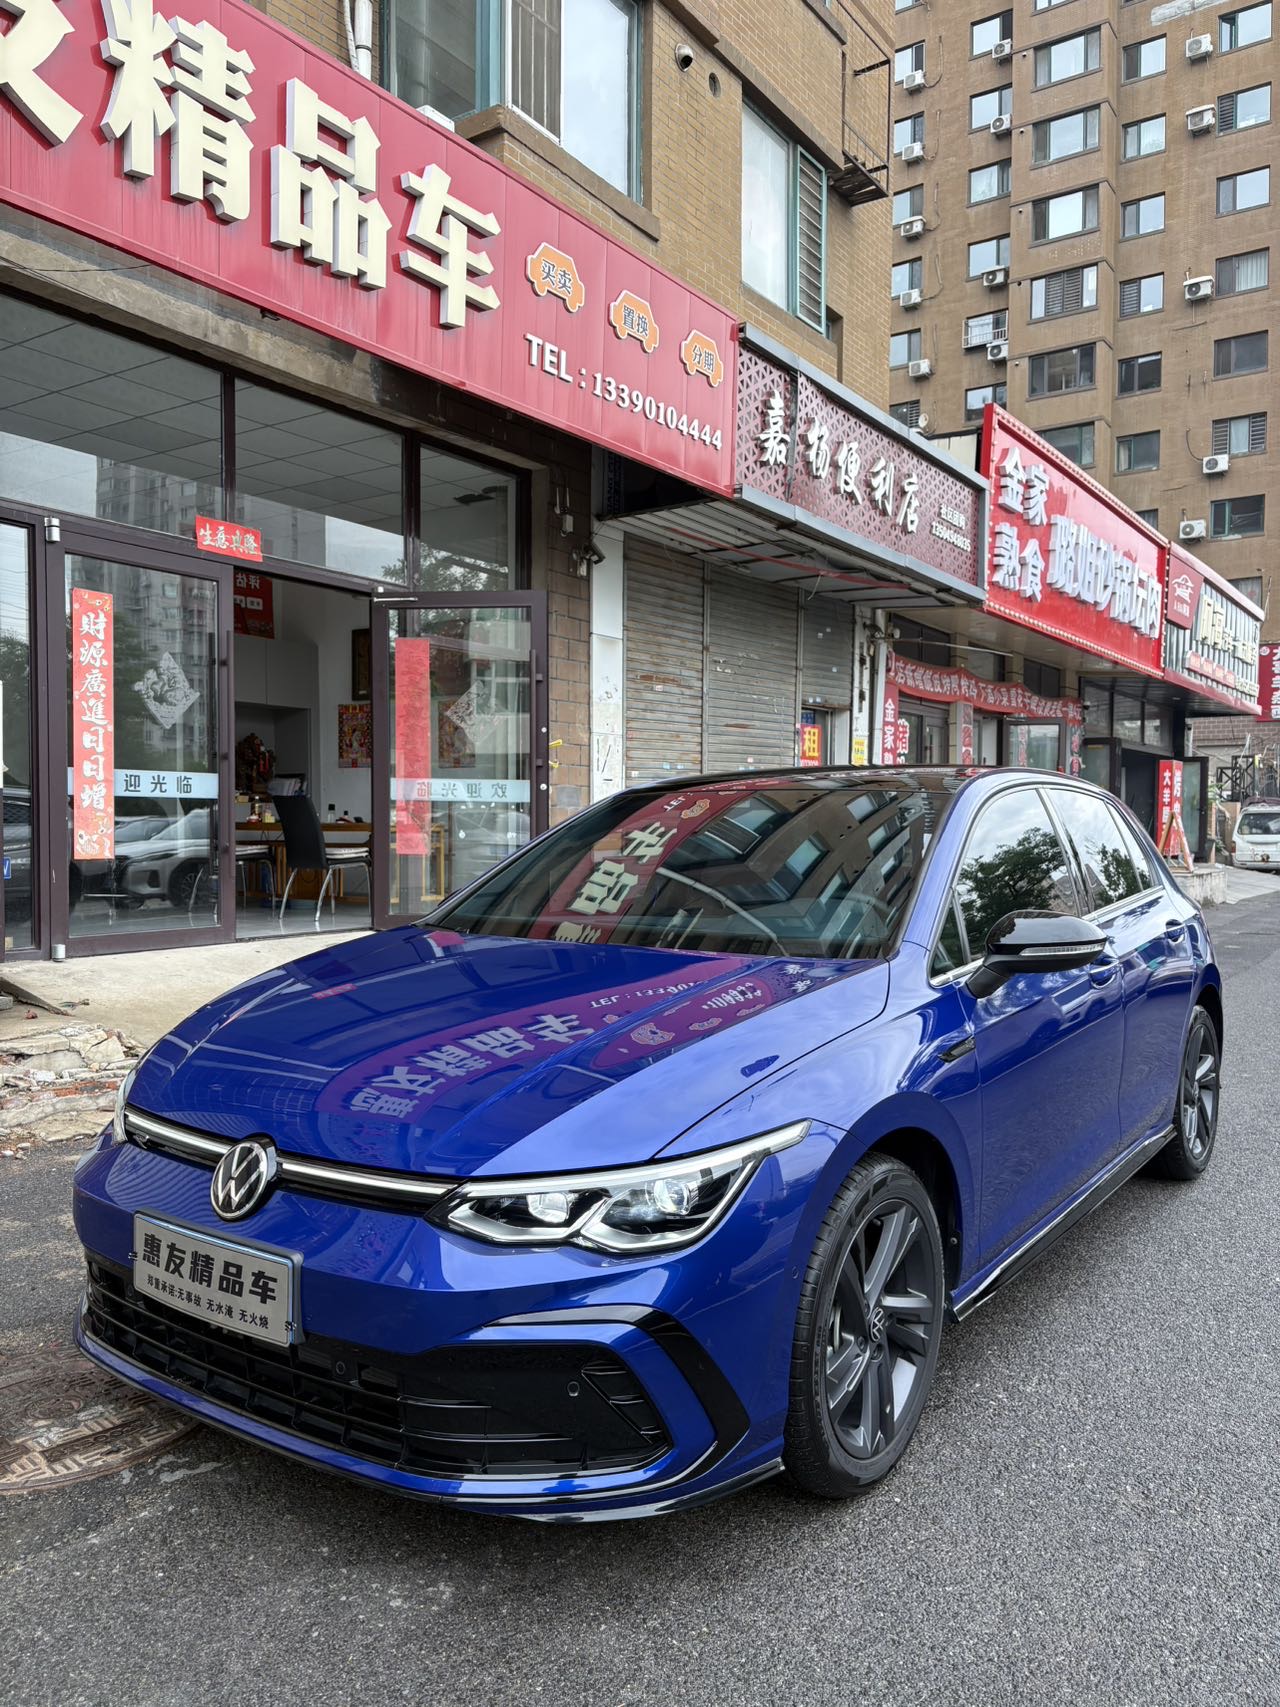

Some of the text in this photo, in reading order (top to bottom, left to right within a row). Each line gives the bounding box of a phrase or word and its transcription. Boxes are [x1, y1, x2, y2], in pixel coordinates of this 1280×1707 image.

[541, 258, 572, 295] 买卖
[622, 304, 649, 337] 置换
[692, 344, 715, 372] 分期
[142, 1232, 278, 1304] 惠友精品车
